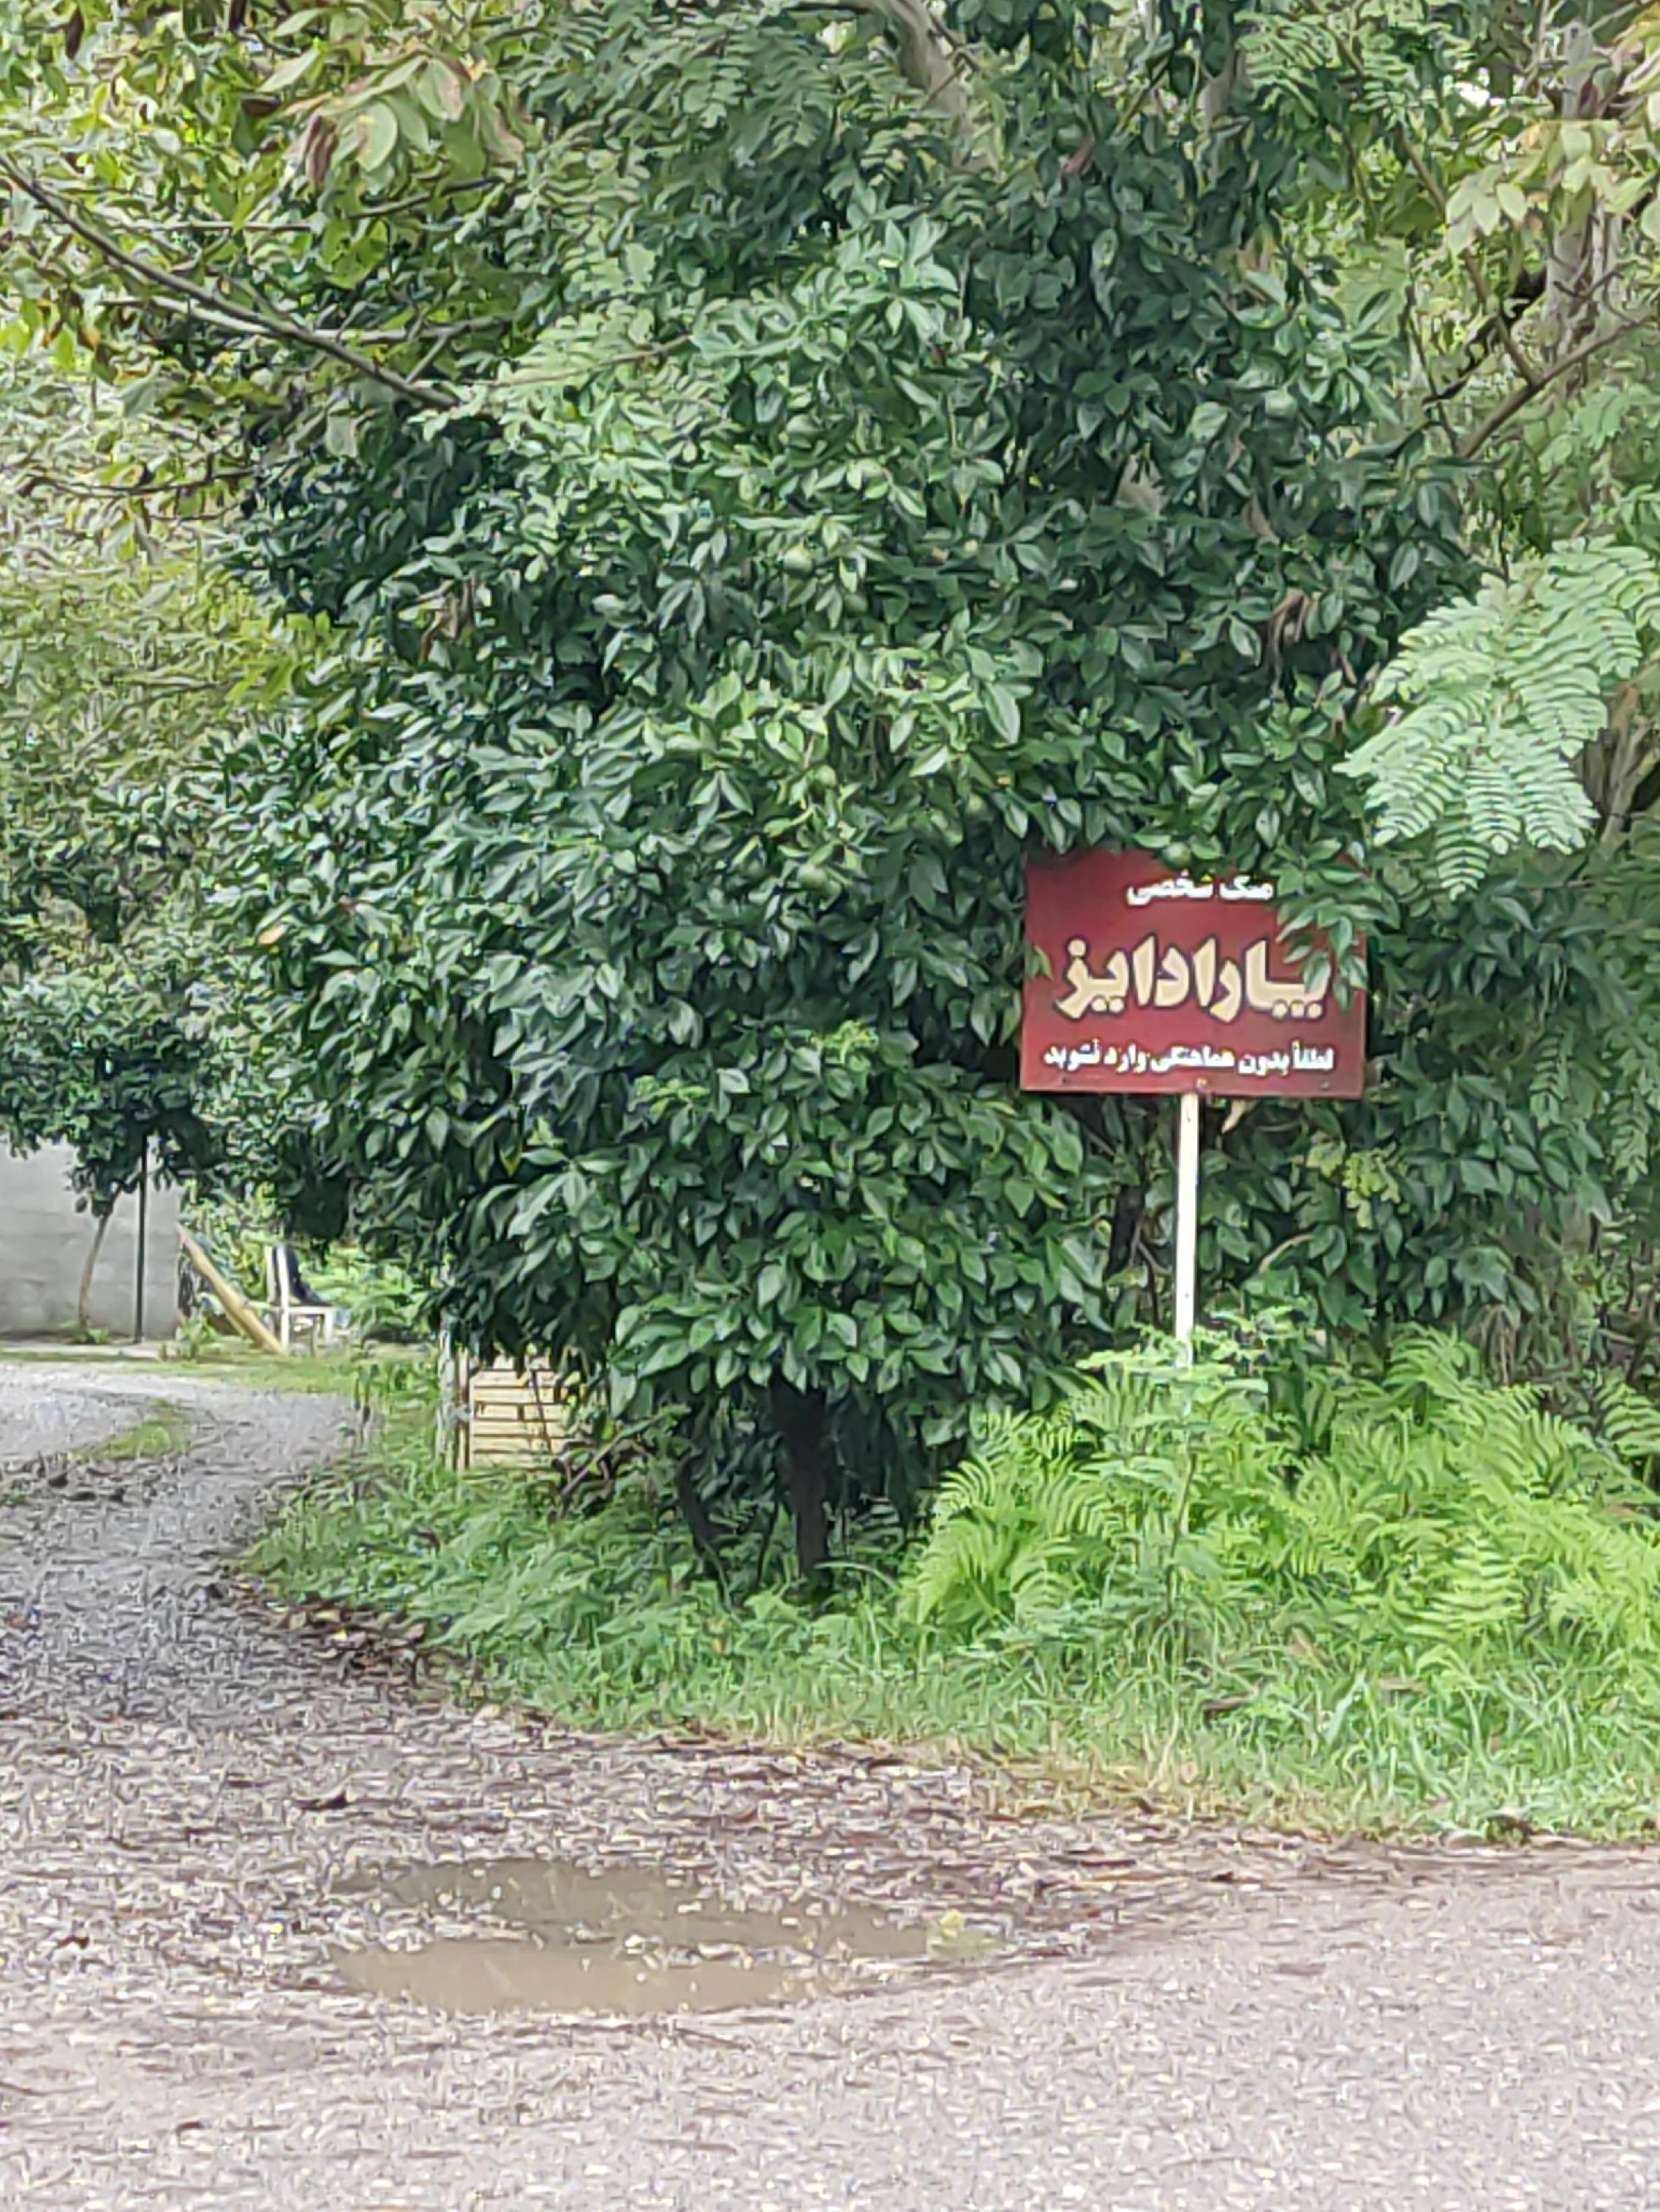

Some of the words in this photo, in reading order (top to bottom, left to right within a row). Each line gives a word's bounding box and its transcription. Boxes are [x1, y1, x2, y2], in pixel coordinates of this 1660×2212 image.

[1056, 935, 1331, 1021] پارادایز
[1044, 1037, 1101, 1072] نشوید
[1103, 1043, 1144, 1072] وارد
[1237, 1049, 1289, 1076] بدون
